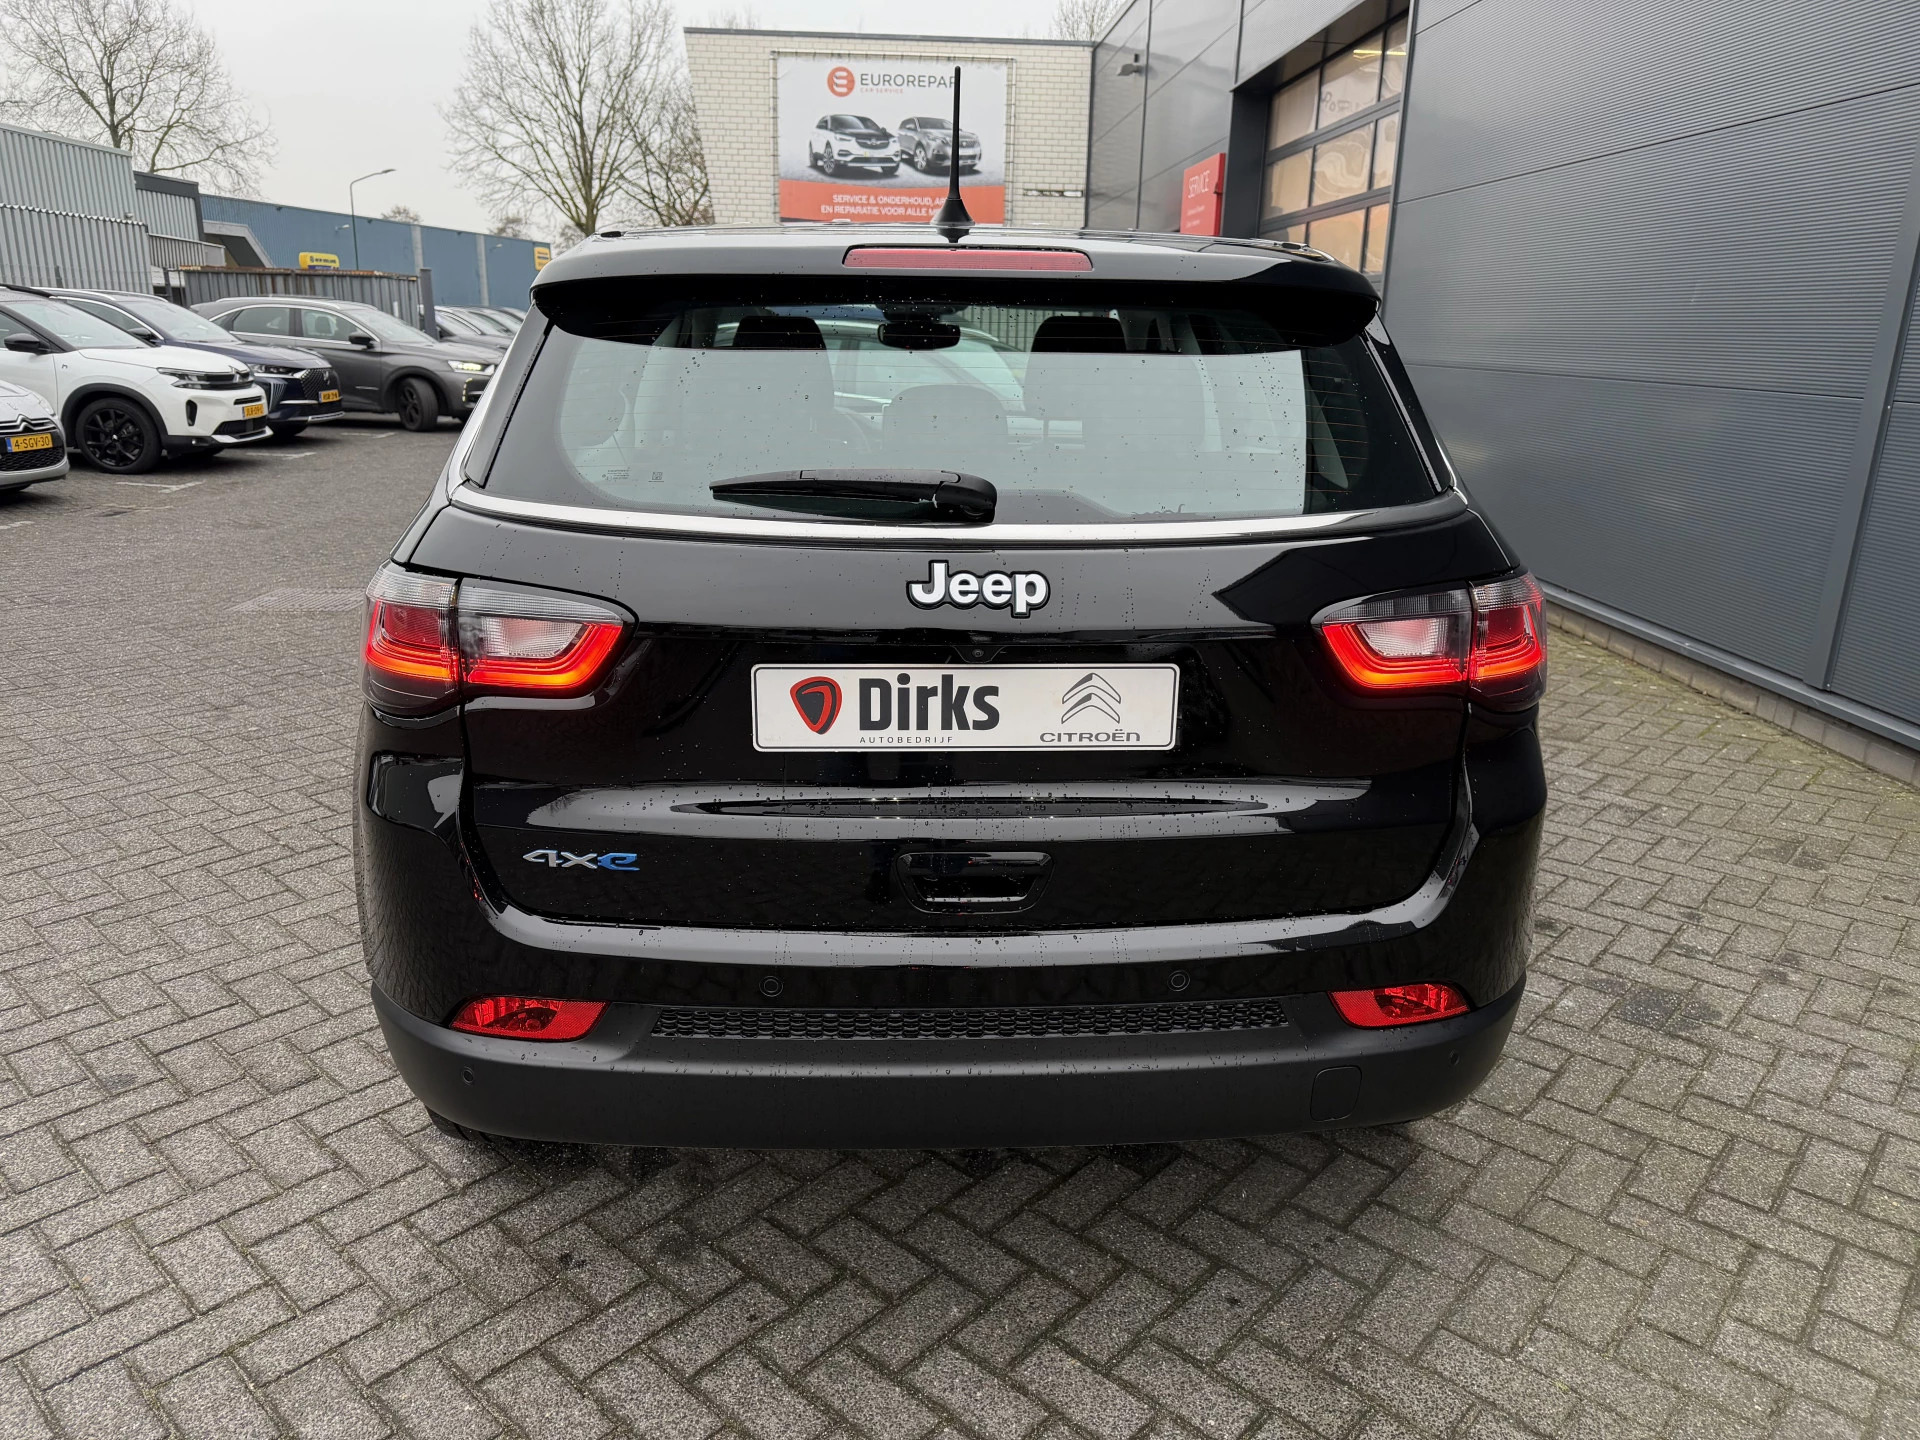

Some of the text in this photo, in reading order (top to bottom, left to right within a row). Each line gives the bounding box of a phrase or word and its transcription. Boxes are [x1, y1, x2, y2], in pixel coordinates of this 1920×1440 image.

[832, 194, 868, 204] SERVICE
[877, 195, 933, 207] ONDERHOUD,
[821, 205, 833, 214] EN
[834, 205, 880, 215] REPARATIE
[880, 206, 905, 216] VOOR
[906, 208, 927, 217] ALLE
[14, 436, 50, 450] 4-SGV-30
[909, 561, 1049, 616] Jeep
[858, 672, 1000, 731] Dirks
[859, 735, 955, 745] AUTOBEDRIJF
